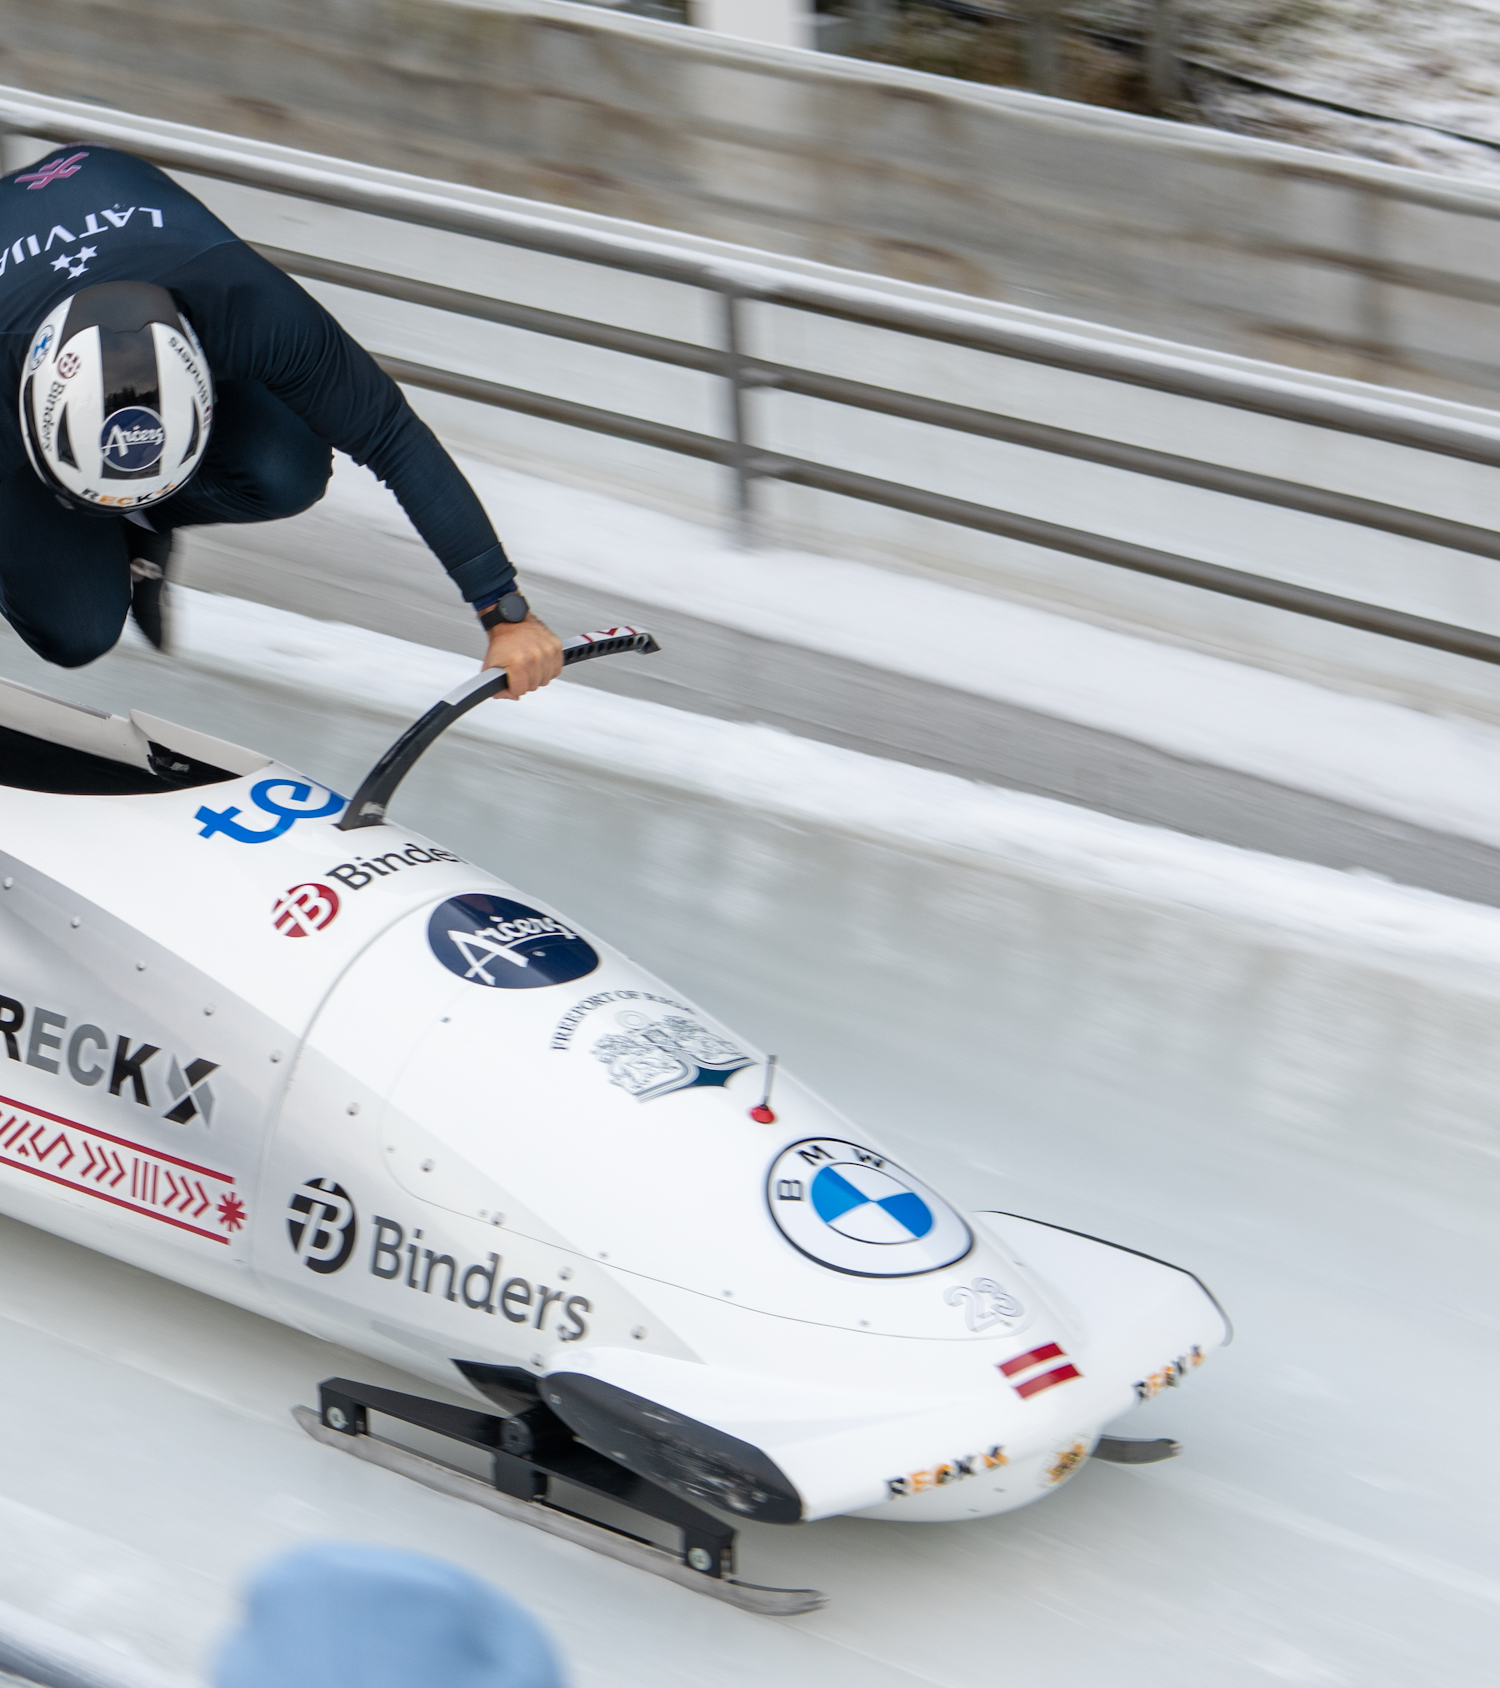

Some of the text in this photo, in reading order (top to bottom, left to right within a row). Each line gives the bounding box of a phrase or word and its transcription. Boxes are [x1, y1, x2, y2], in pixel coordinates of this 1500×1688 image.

[41, 380, 66, 452] Binders
[194, 776, 352, 844] te
[777, 1144, 886, 1202] BMW
[369, 1214, 593, 1342] Binders
[942, 1276, 1026, 1333] 23
